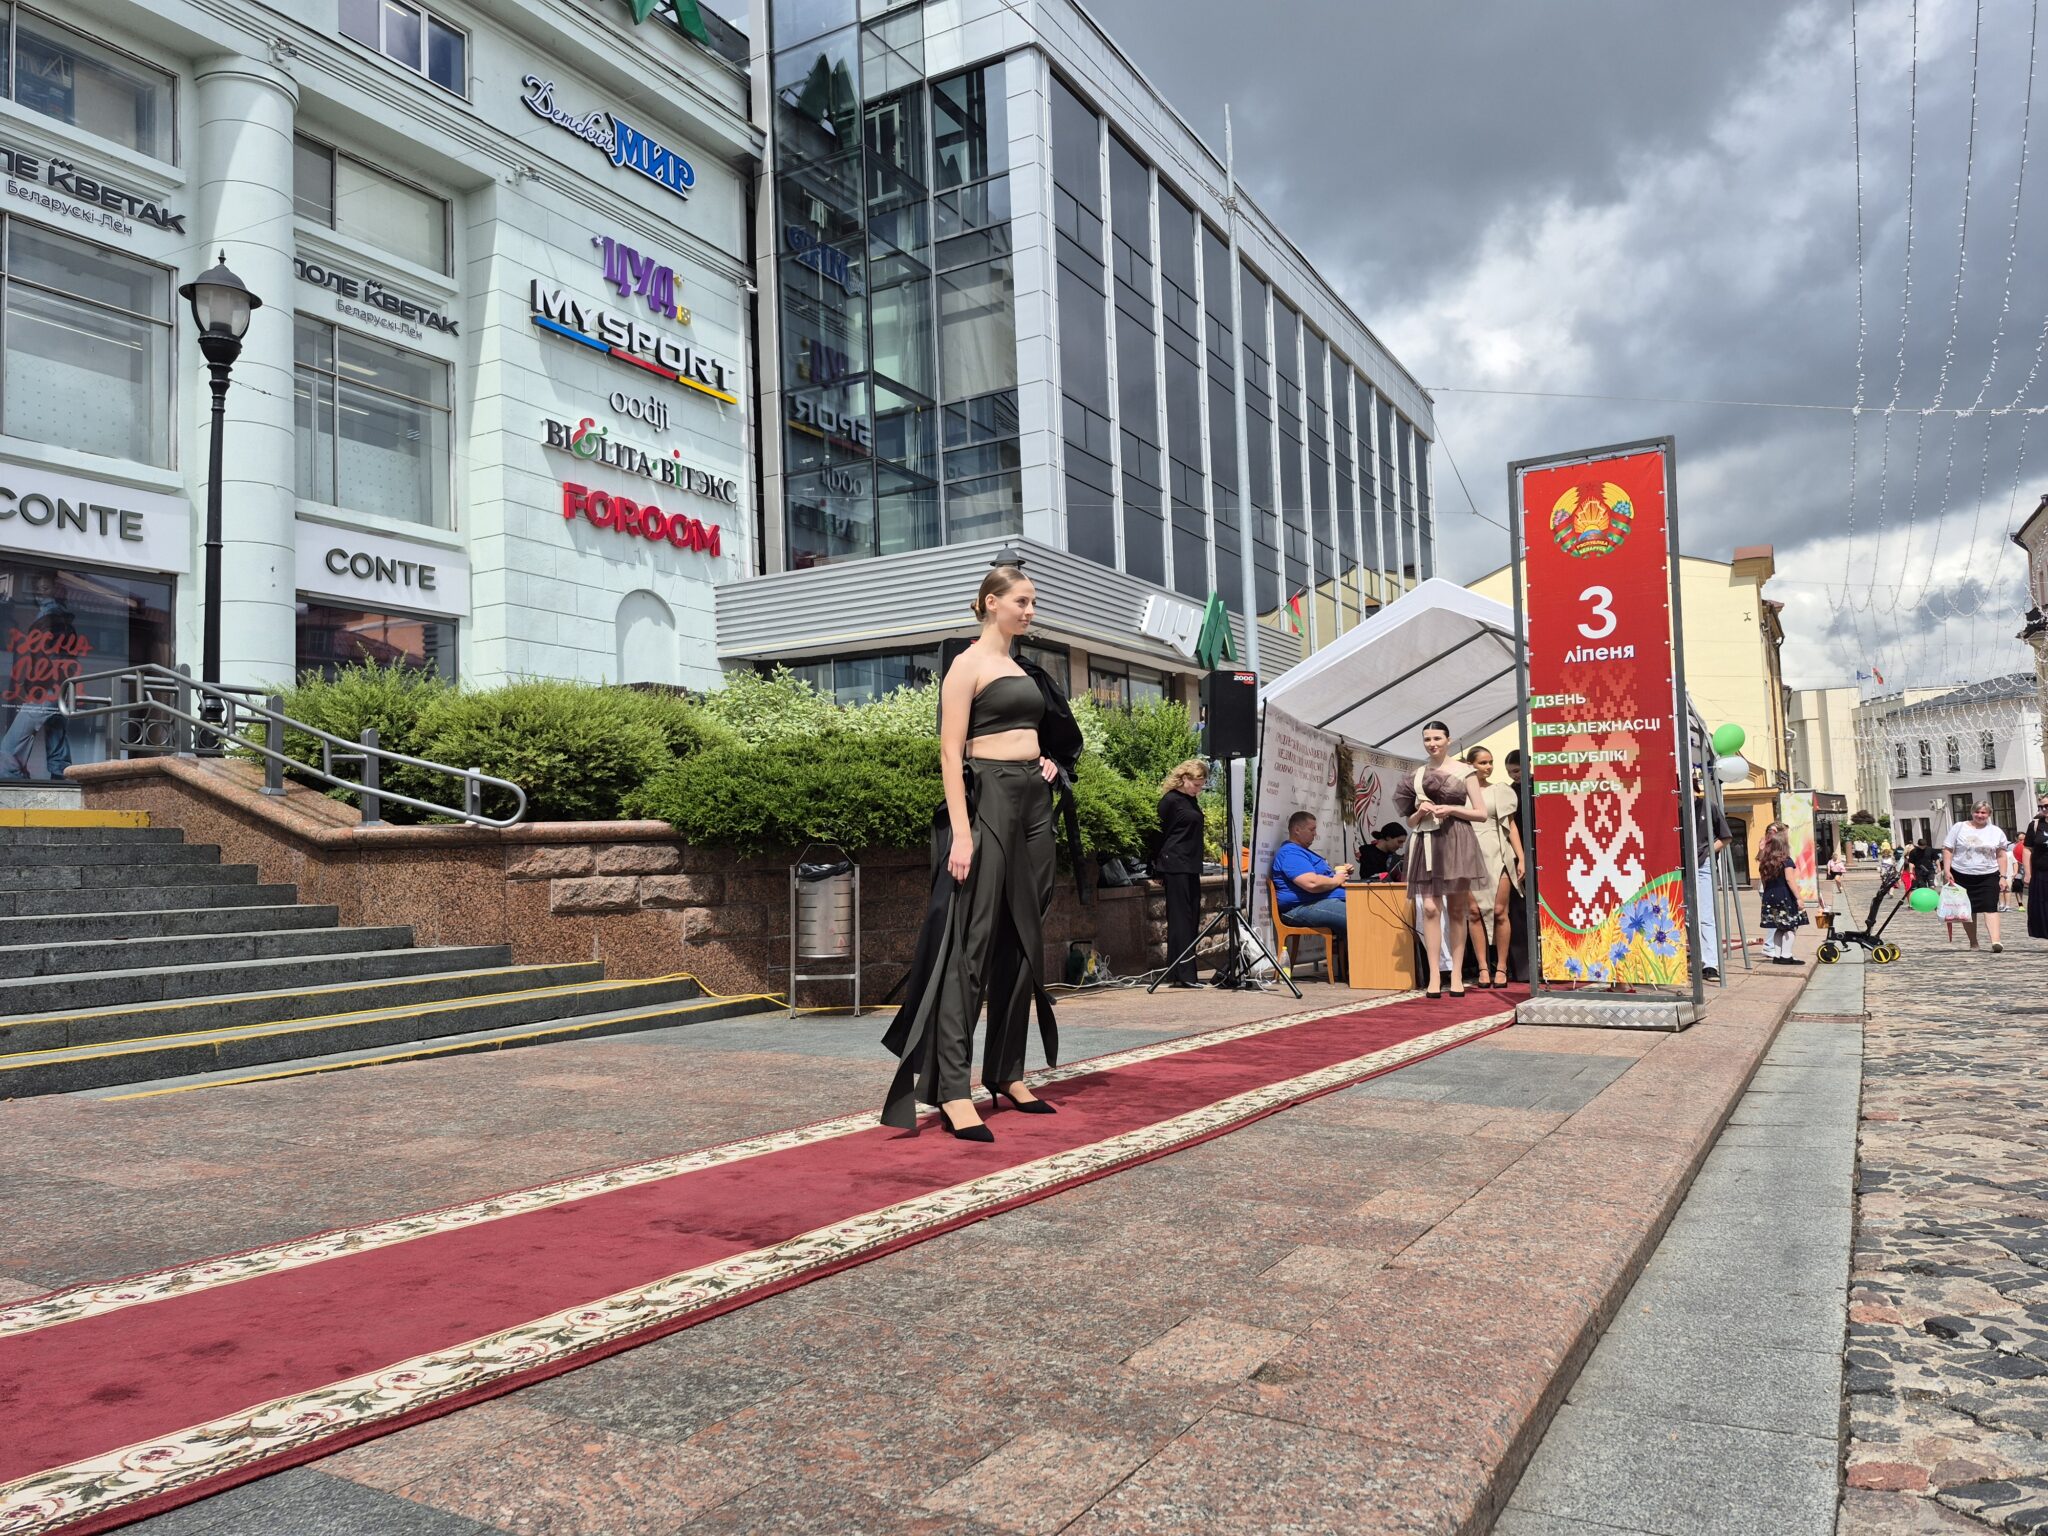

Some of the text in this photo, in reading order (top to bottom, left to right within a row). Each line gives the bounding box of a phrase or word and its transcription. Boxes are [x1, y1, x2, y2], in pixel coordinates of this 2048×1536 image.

[521, 74, 696, 200] Детский МИР
[48, 160, 186, 234] КВЕТАК
[364, 280, 460, 337] КВЕТАК
[610, 391, 671, 433] oodji
[563, 482, 721, 557] FOROOM
[326, 548, 436, 590] CONTE
[1577, 586, 1617, 639] 3
[1564, 645, 1635, 664] ліпеня
[1534, 693, 1586, 708] ДЗЕНЬ
[1536, 718, 1660, 736] НЕЗАЛЕЖНАСЦІ
[1537, 750, 1628, 765] РЭСПУБЛІКІ
[1539, 780, 1622, 794] БЕЛАРУСЬ
